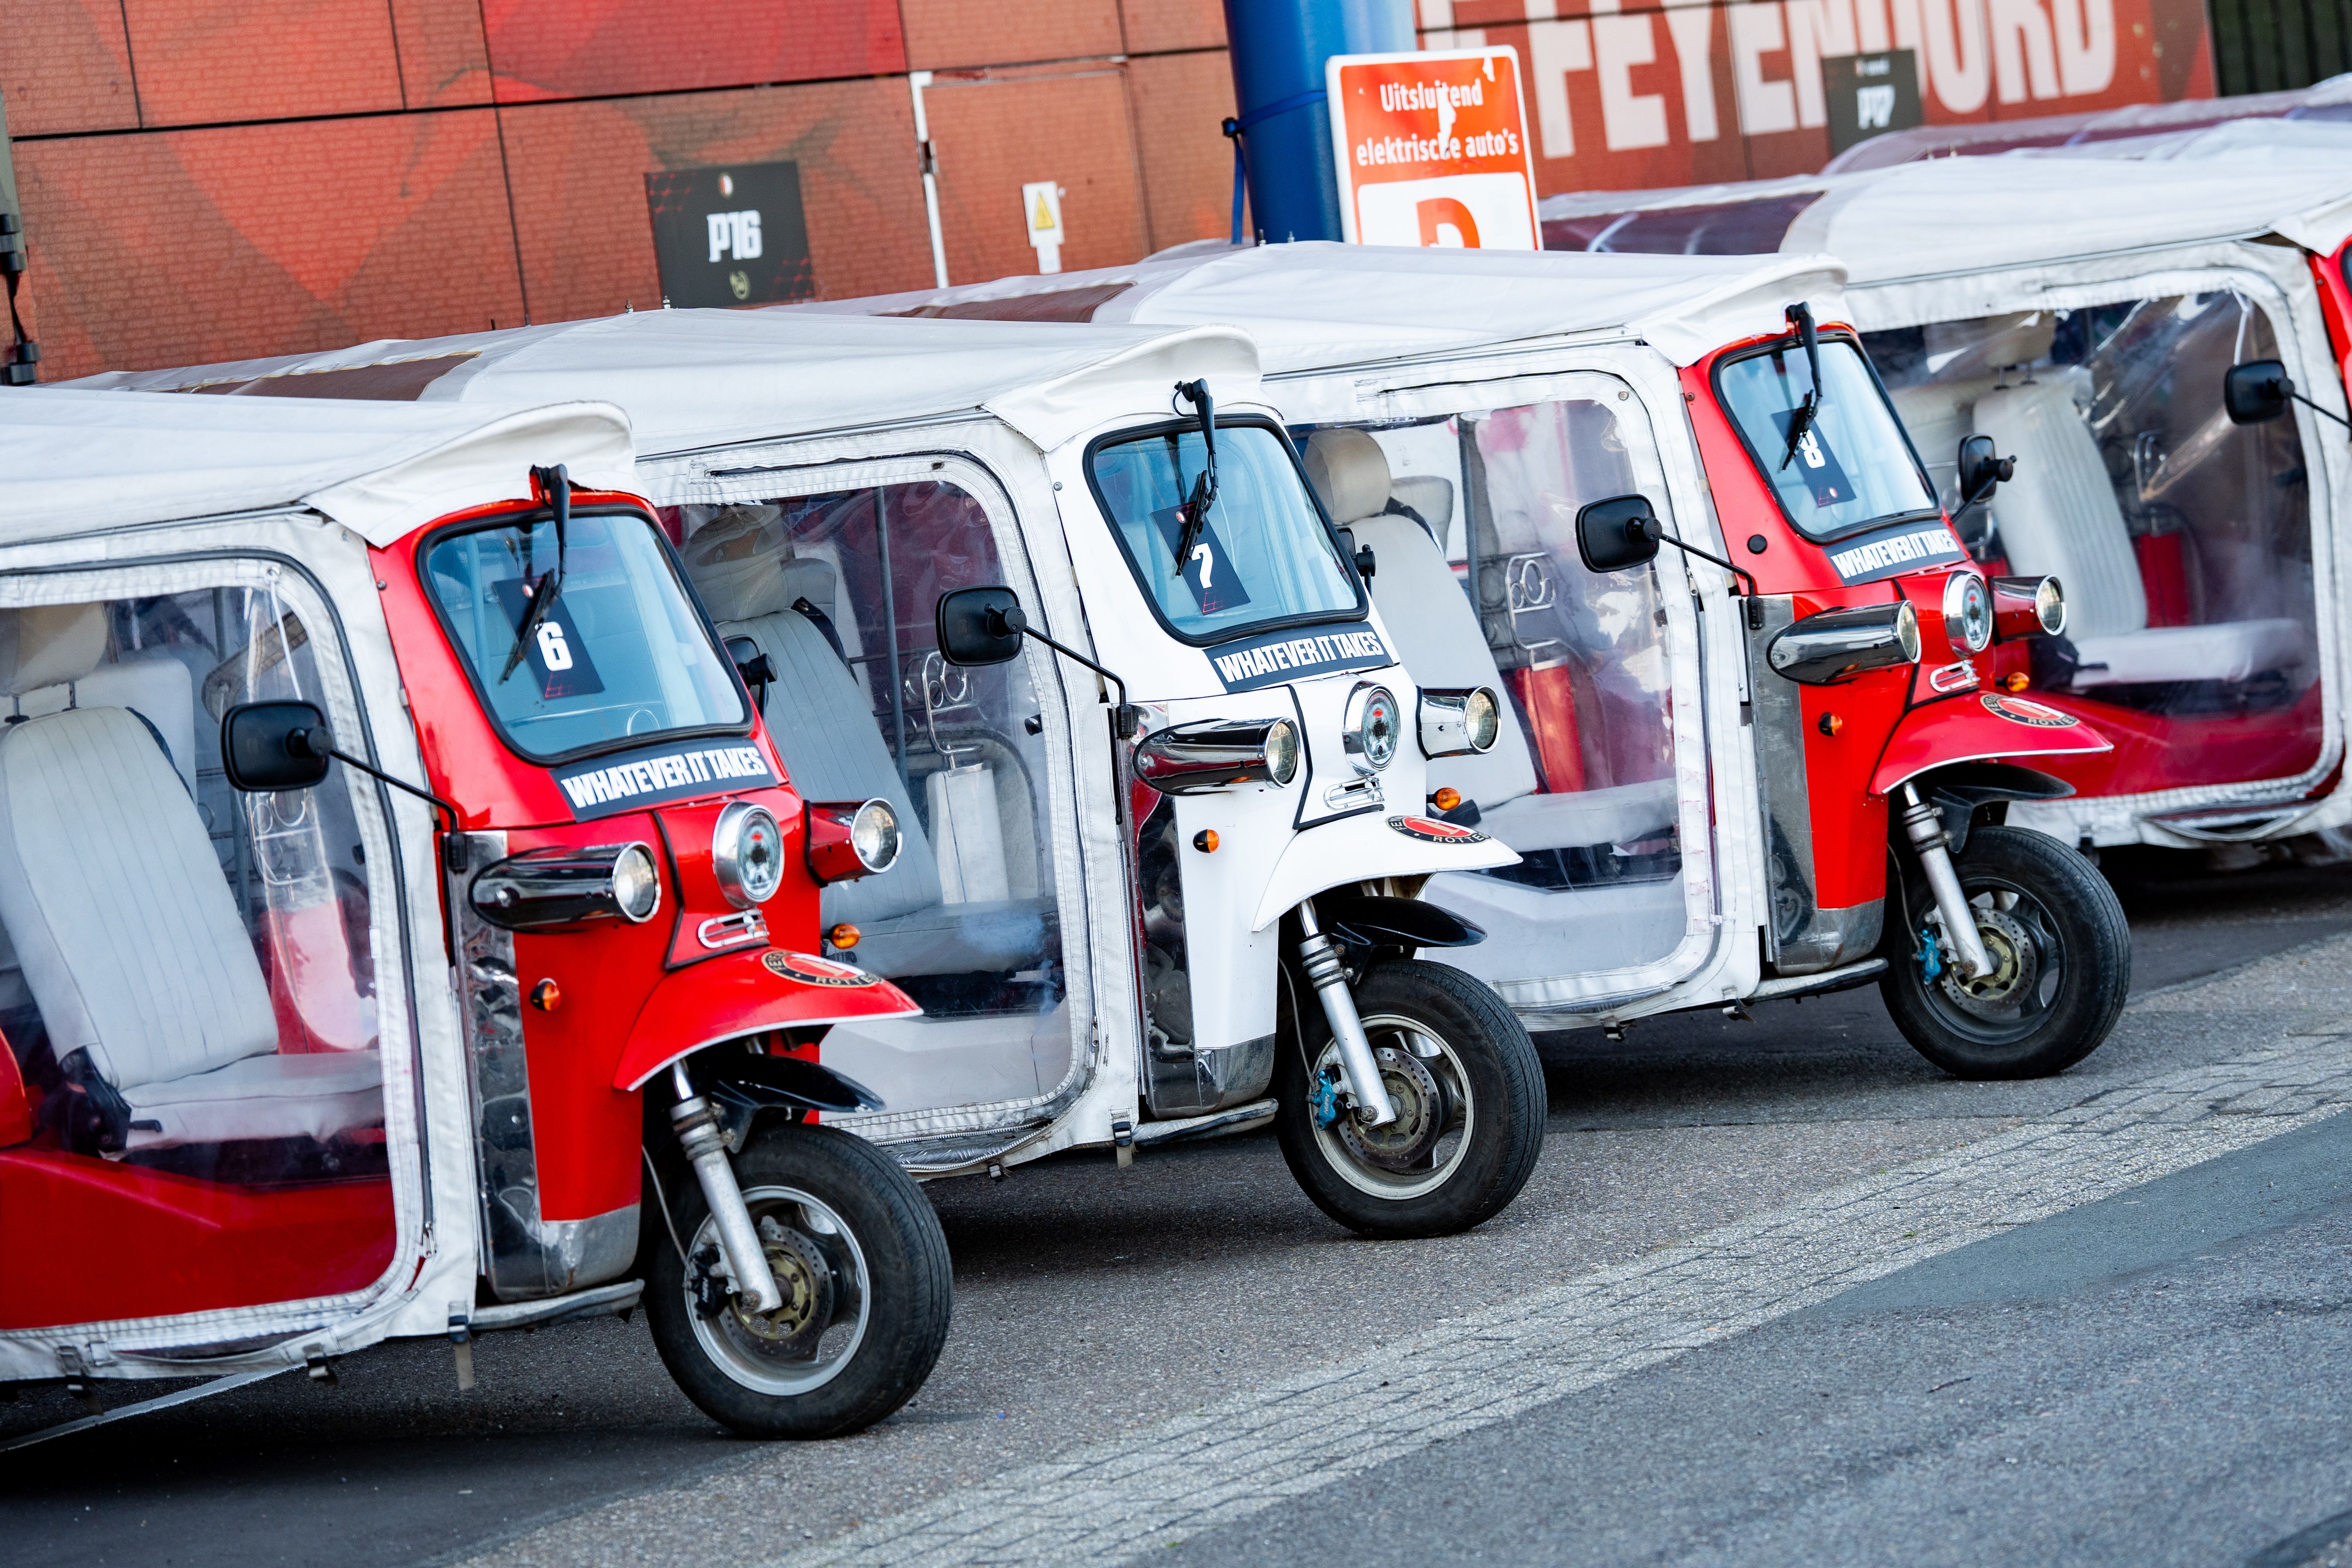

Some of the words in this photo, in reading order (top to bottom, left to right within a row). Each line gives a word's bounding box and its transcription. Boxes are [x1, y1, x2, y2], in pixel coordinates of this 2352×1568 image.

[1380, 78, 1484, 112] Uitsluitend
[1465, 128, 1519, 157] auto's
[706, 210, 763, 263] P16
[1800, 429, 1825, 469] 8
[1191, 542, 1213, 589] 7
[1830, 535, 1917, 578] WHATEVER
[1907, 532, 1927, 558] IT
[1918, 529, 1959, 555] TAKES
[535, 621, 573, 671] 6
[1214, 638, 1323, 683] WHATEVER
[1314, 635, 1337, 661] IT
[1329, 631, 1384, 659] TAKES
[561, 754, 694, 808] WHATEVER
[685, 751, 711, 783] IT
[704, 747, 768, 780] TAKES
